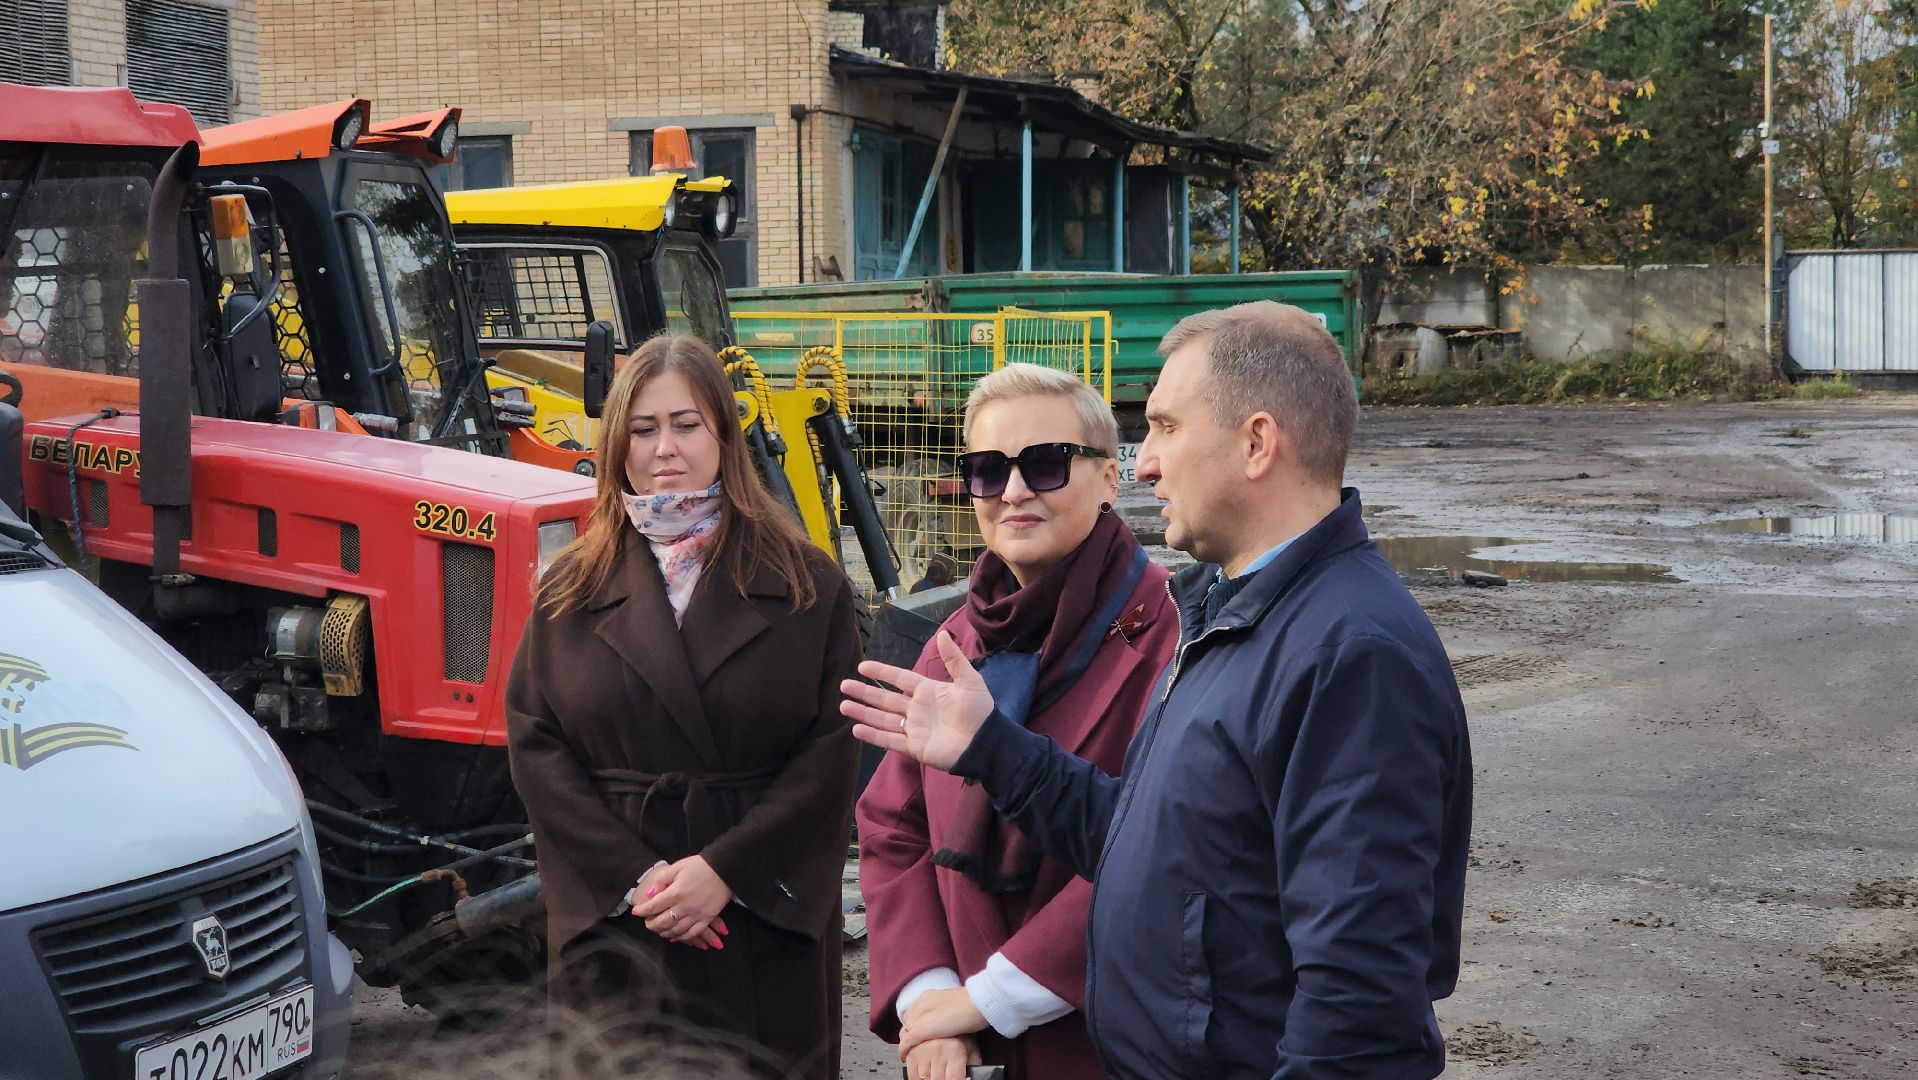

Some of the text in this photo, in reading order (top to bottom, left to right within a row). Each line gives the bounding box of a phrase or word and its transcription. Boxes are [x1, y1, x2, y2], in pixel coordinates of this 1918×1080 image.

[976, 329, 994, 341] 35
[413, 499, 497, 542] 320.4
[269, 997, 306, 1048] 790
[277, 1042, 296, 1062] RUS
